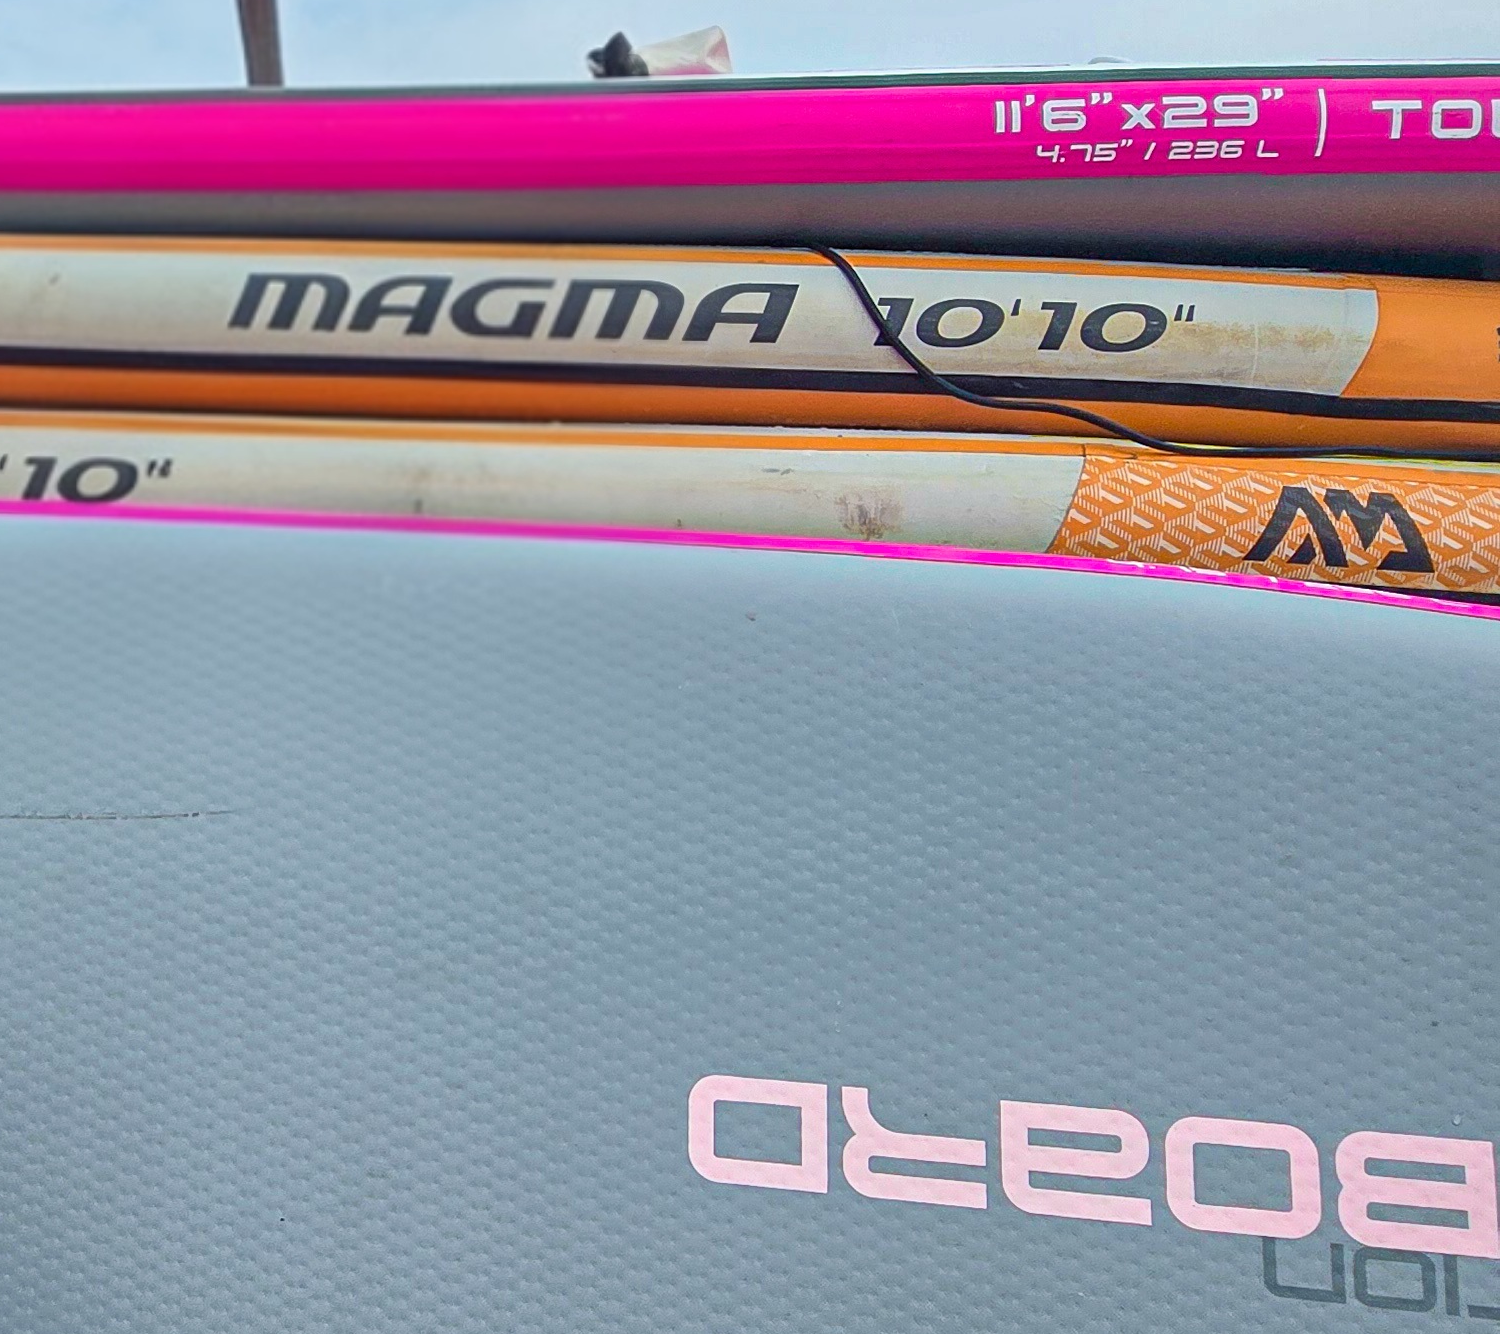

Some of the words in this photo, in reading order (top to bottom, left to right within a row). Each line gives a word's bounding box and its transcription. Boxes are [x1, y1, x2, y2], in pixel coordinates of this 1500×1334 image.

[1370, 98, 1500, 140] TO
[1167, 140, 1246, 160] 236
[1256, 139, 1280, 158] L
[227, 272, 800, 344] MAGMA
[872, 296, 1196, 353] 10'10"
